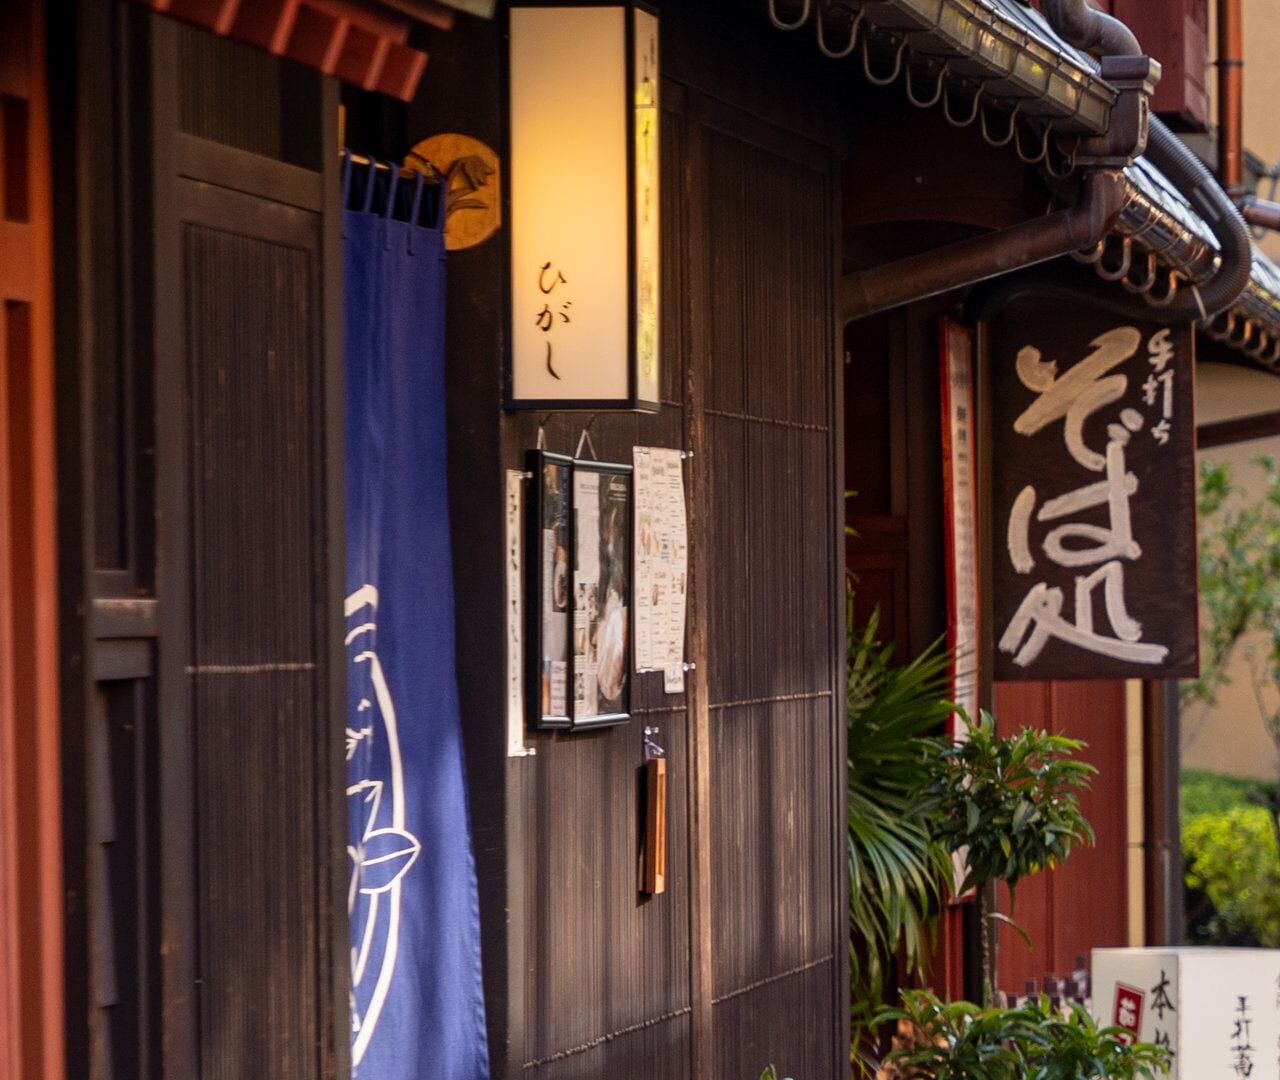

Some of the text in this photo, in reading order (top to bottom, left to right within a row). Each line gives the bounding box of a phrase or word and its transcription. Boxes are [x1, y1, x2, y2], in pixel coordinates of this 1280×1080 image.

[535, 261, 572, 381] ひがし
[1141, 328, 1175, 445] 手打ち
[998, 326, 1170, 667] そば処
